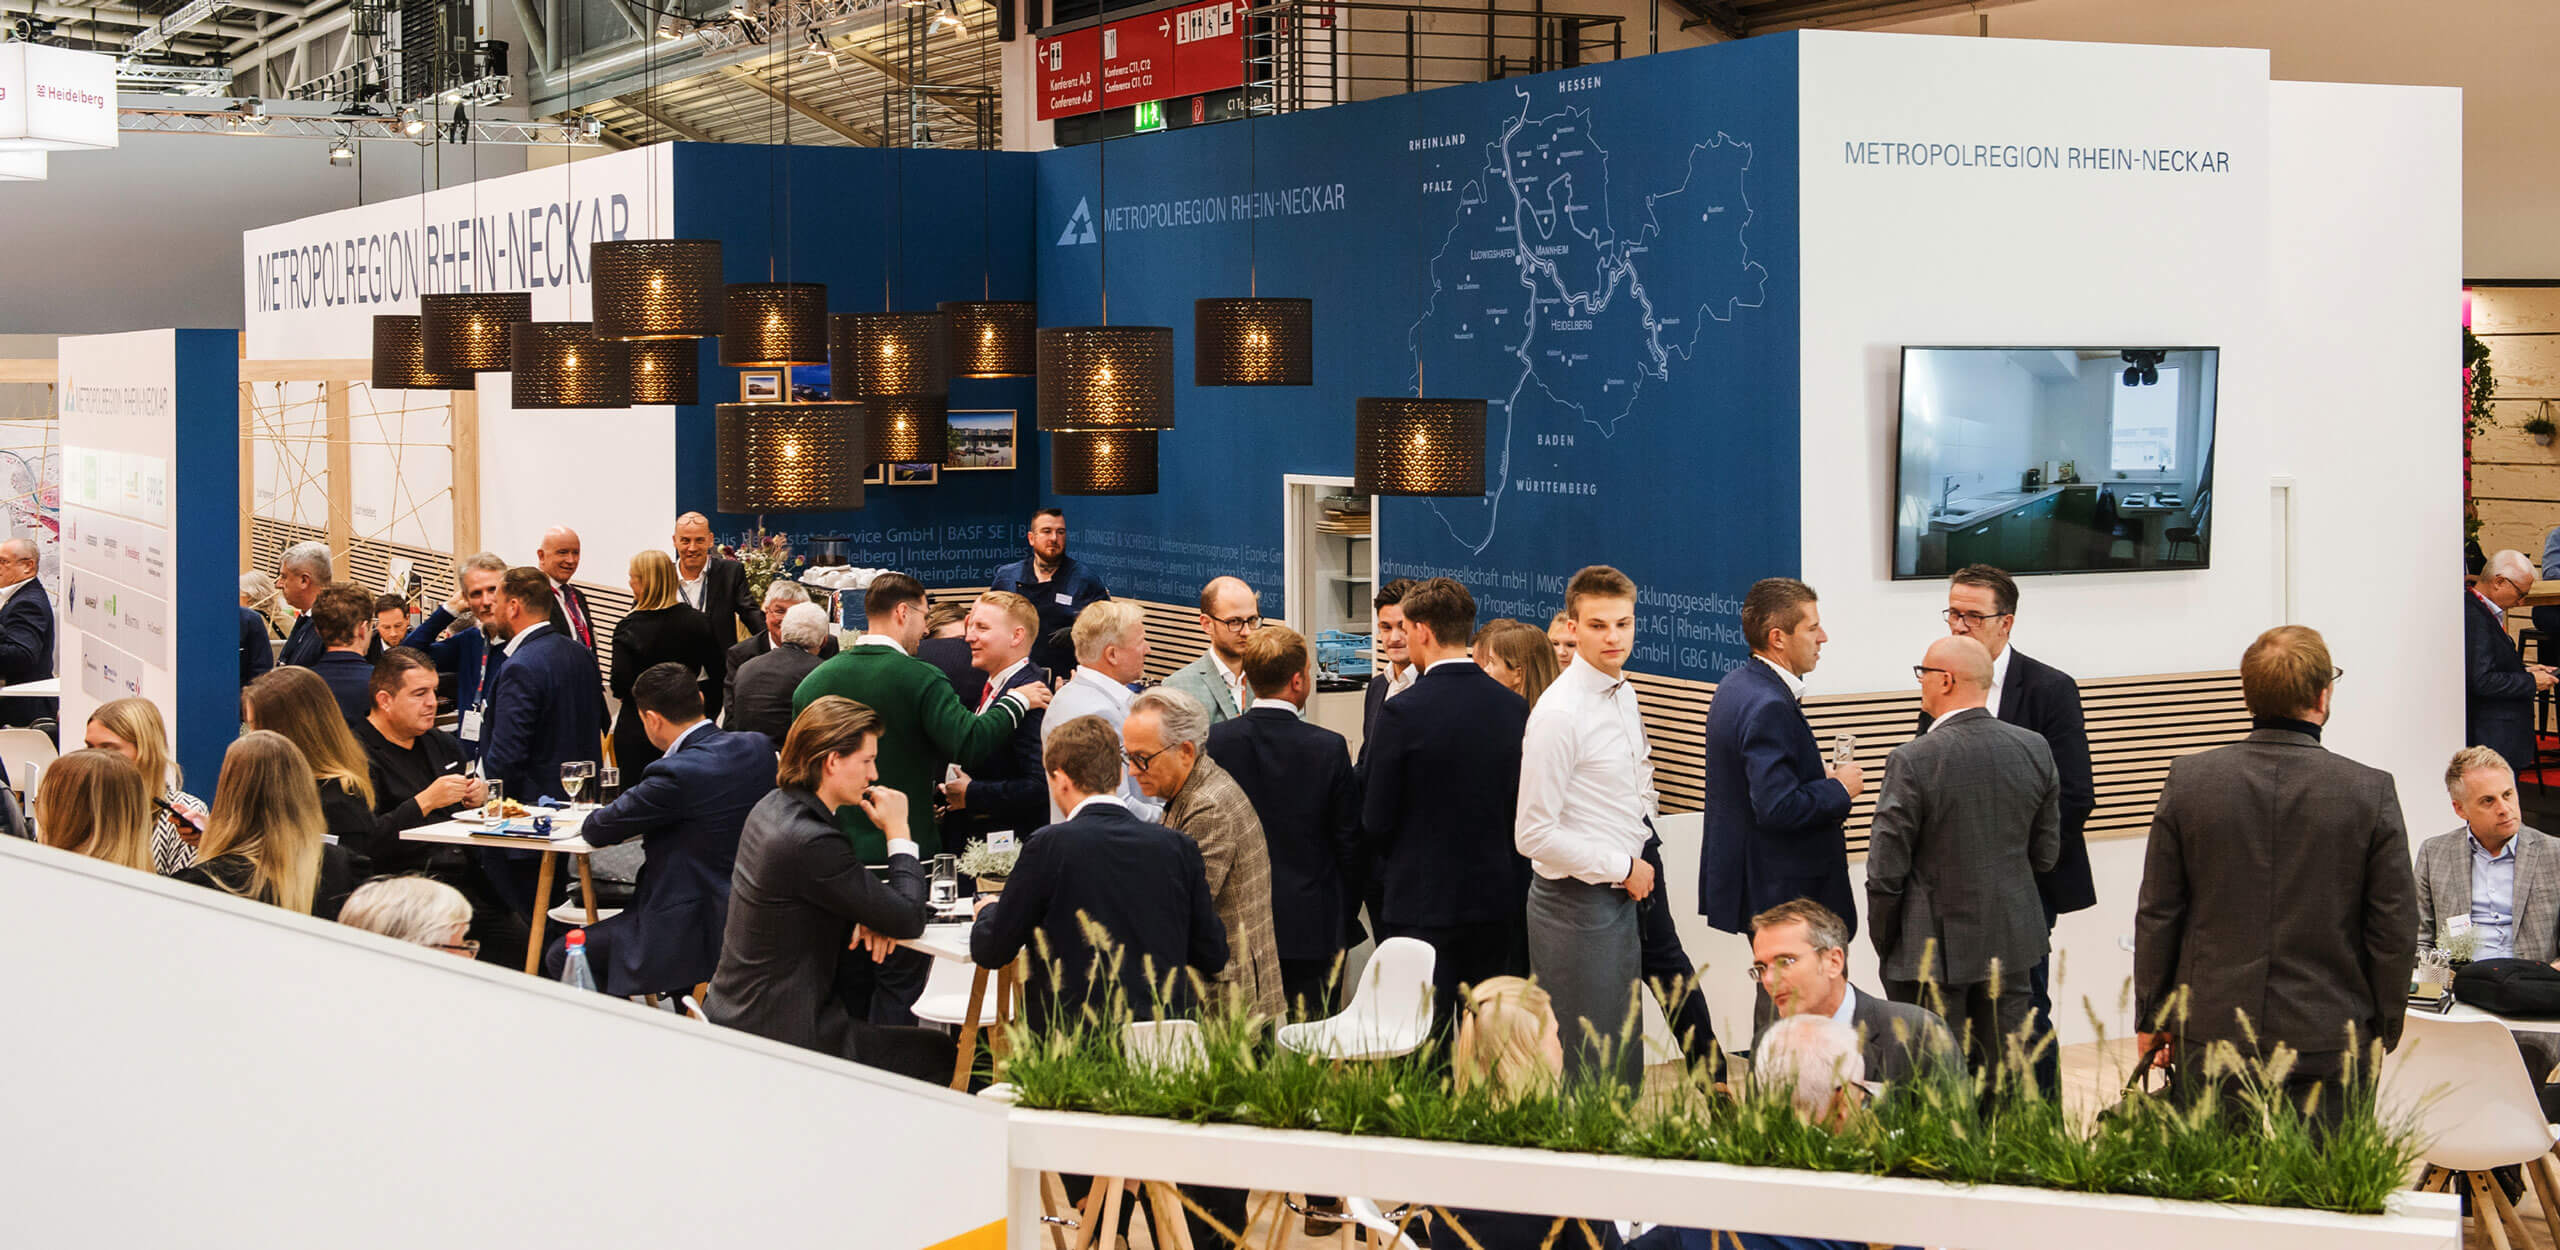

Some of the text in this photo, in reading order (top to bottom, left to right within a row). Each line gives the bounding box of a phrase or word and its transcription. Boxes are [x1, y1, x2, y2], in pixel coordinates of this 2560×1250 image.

[1050, 71, 1092, 91] Konferenz A,B
[1104, 65, 1129, 79] Konferenz
[1104, 80, 1131, 93] Conference
[1558, 76, 1602, 94] HESSEN
[48, 86, 104, 109] Heidelberg
[1050, 94, 1081, 110] Conference
[1408, 133, 1466, 152] RHEINLAND
[1844, 140, 2231, 174] METROPOLREGION RHEIN-NECKAR
[1422, 179, 1453, 195] PFALZ
[1103, 183, 1345, 233] METROPOLREGION RHEIN-NECKAR
[257, 192, 630, 314] METROPOLREGION RHEIN-NECKAR
[1470, 247, 1515, 261] LUDWIGSHAFEN
[1535, 244, 1569, 256] MANNHEIM
[1551, 319, 1593, 331] HEIDELBERG
[1537, 433, 1575, 447] BADEN
[1516, 478, 1598, 496] WÜRTTEMBERG
[886, 527, 934, 543] GmbH
[947, 525, 984, 541] BASF
[987, 525, 1006, 540] SE
[907, 543, 1028, 563] Interkommunales
[904, 564, 981, 583] Rheinpfalz
[1502, 569, 1527, 590] mbH
[1536, 574, 1564, 595] MWS
[1483, 593, 1536, 618] Properties
[1651, 615, 1669, 636] AG
[1677, 617, 1747, 646] Rhein-Neck
[1632, 640, 1670, 665] GmbH
[1680, 646, 1708, 670] GBG
